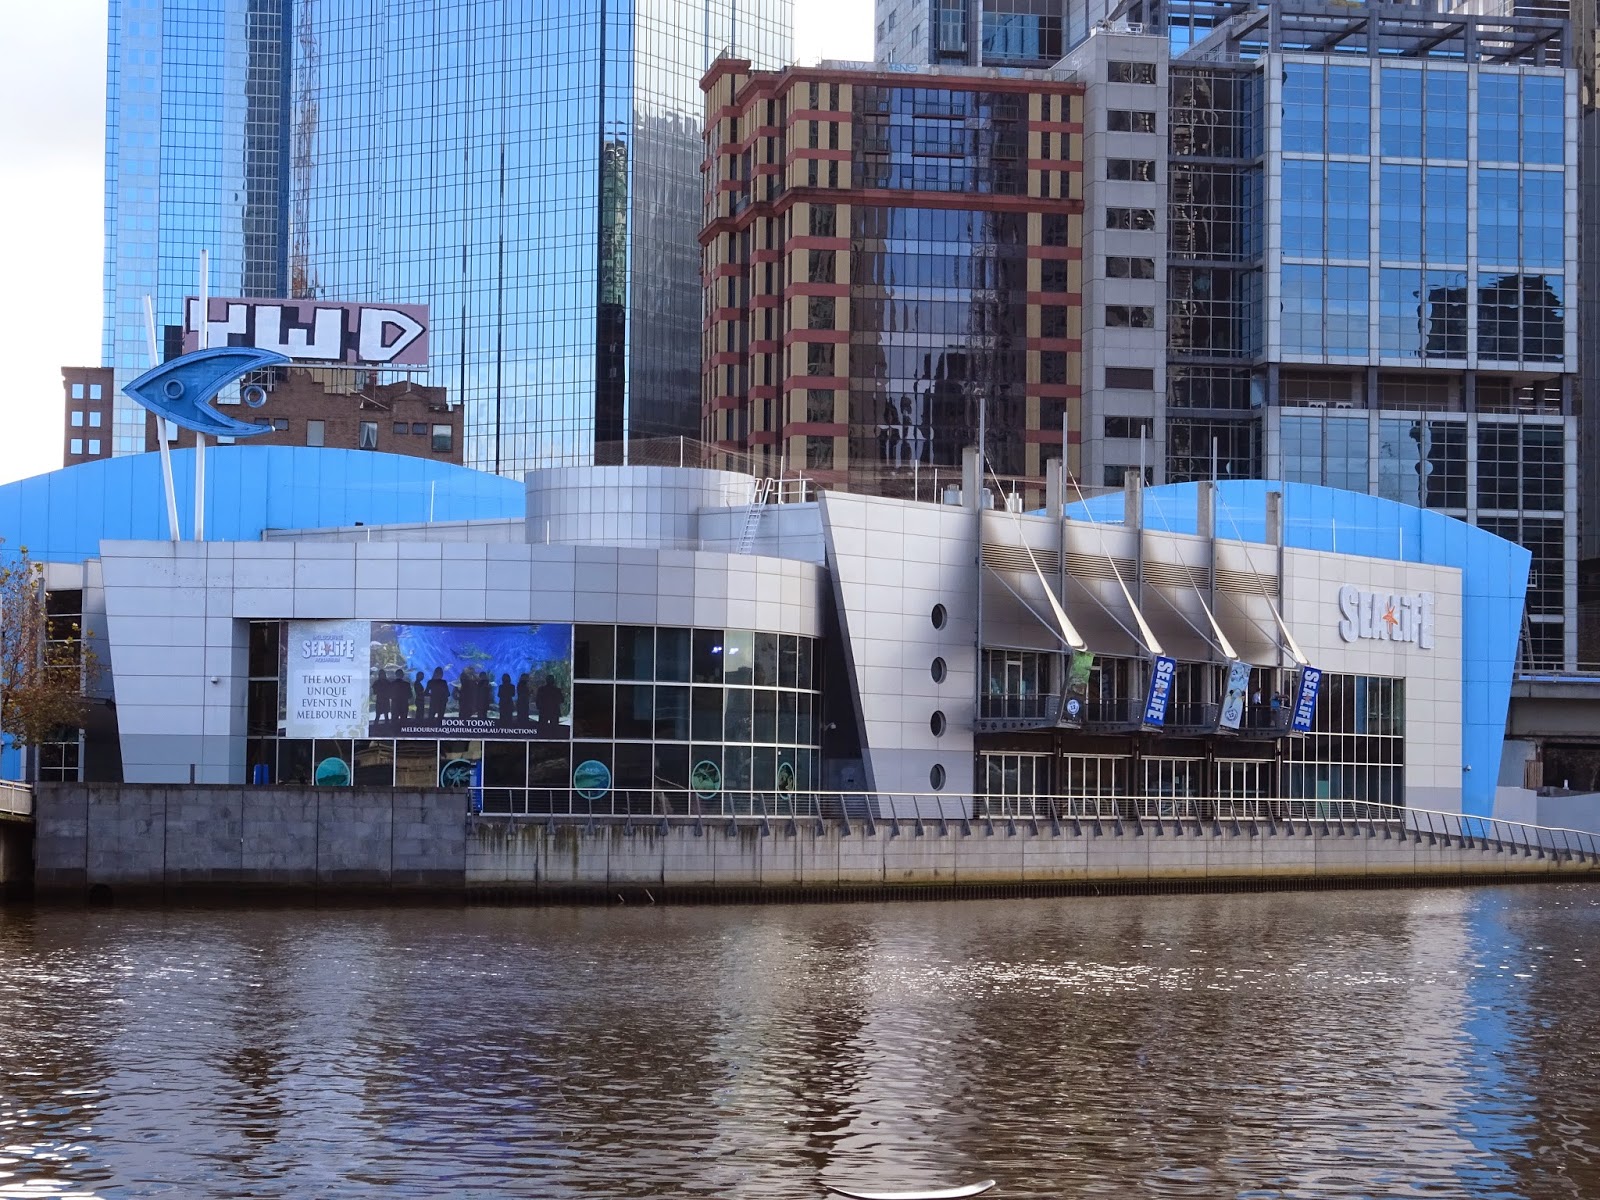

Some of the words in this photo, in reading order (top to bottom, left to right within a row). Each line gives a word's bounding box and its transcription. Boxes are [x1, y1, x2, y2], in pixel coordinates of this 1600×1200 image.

[302, 675, 320, 684] THE
[324, 675, 352, 684] MOST
[307, 687, 347, 697] UNIQUE
[302, 699, 338, 707] EVENTS
[340, 699, 352, 707] IN
[297, 711, 357, 719] MELBOURNE
